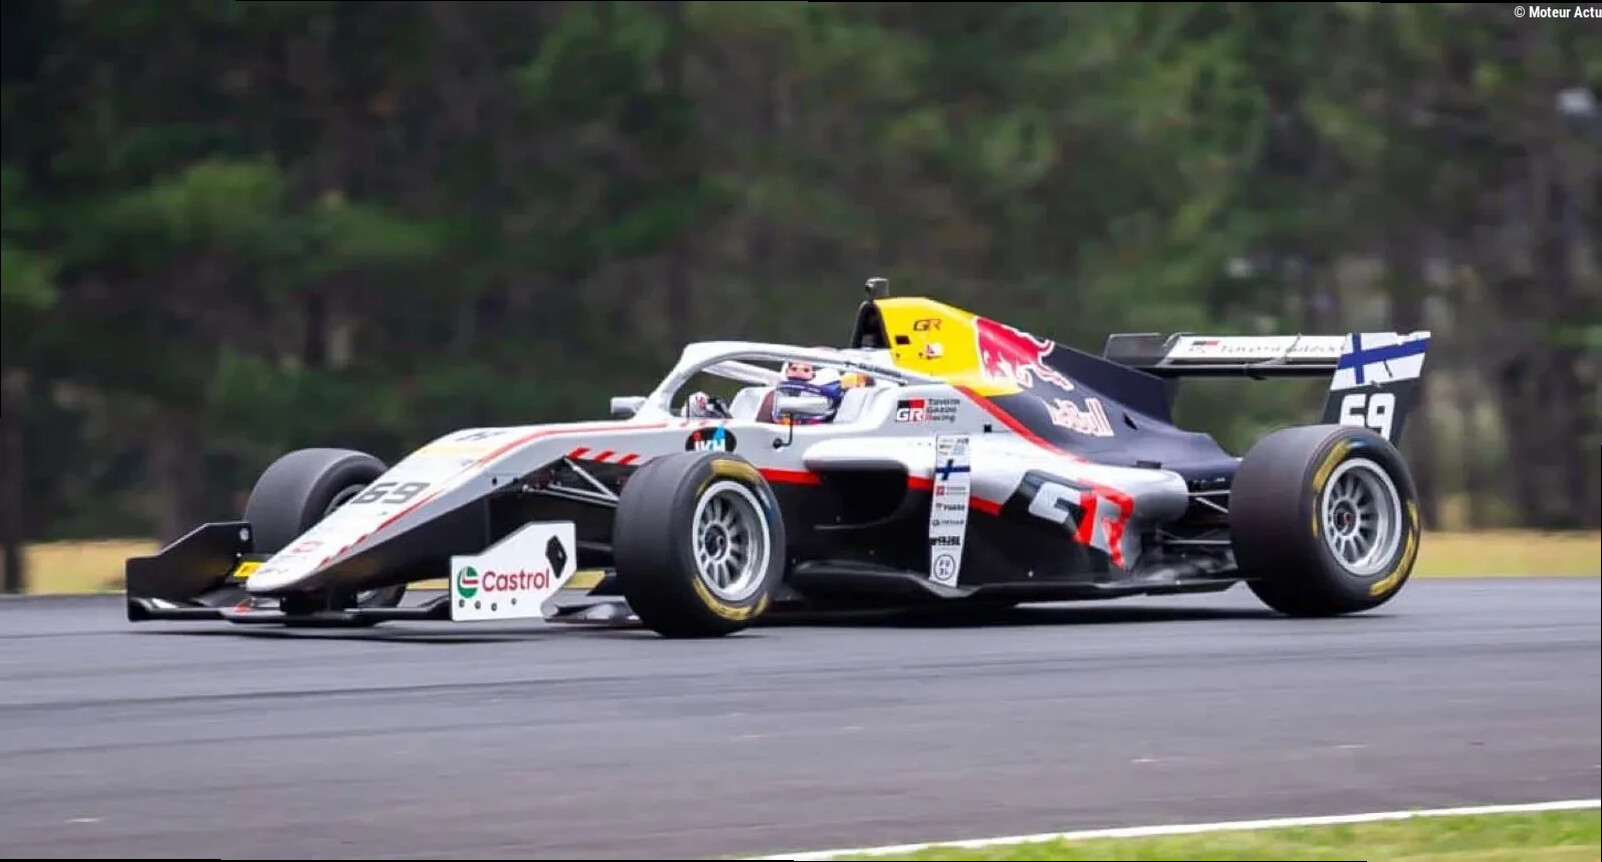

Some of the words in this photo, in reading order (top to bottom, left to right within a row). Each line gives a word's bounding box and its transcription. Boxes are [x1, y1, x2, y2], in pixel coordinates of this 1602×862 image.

[913, 319, 941, 331] GR
[896, 408, 924, 421] GR
[1340, 393, 1396, 441] 69
[351, 482, 430, 504] 69
[482, 568, 550, 592] Castrol
